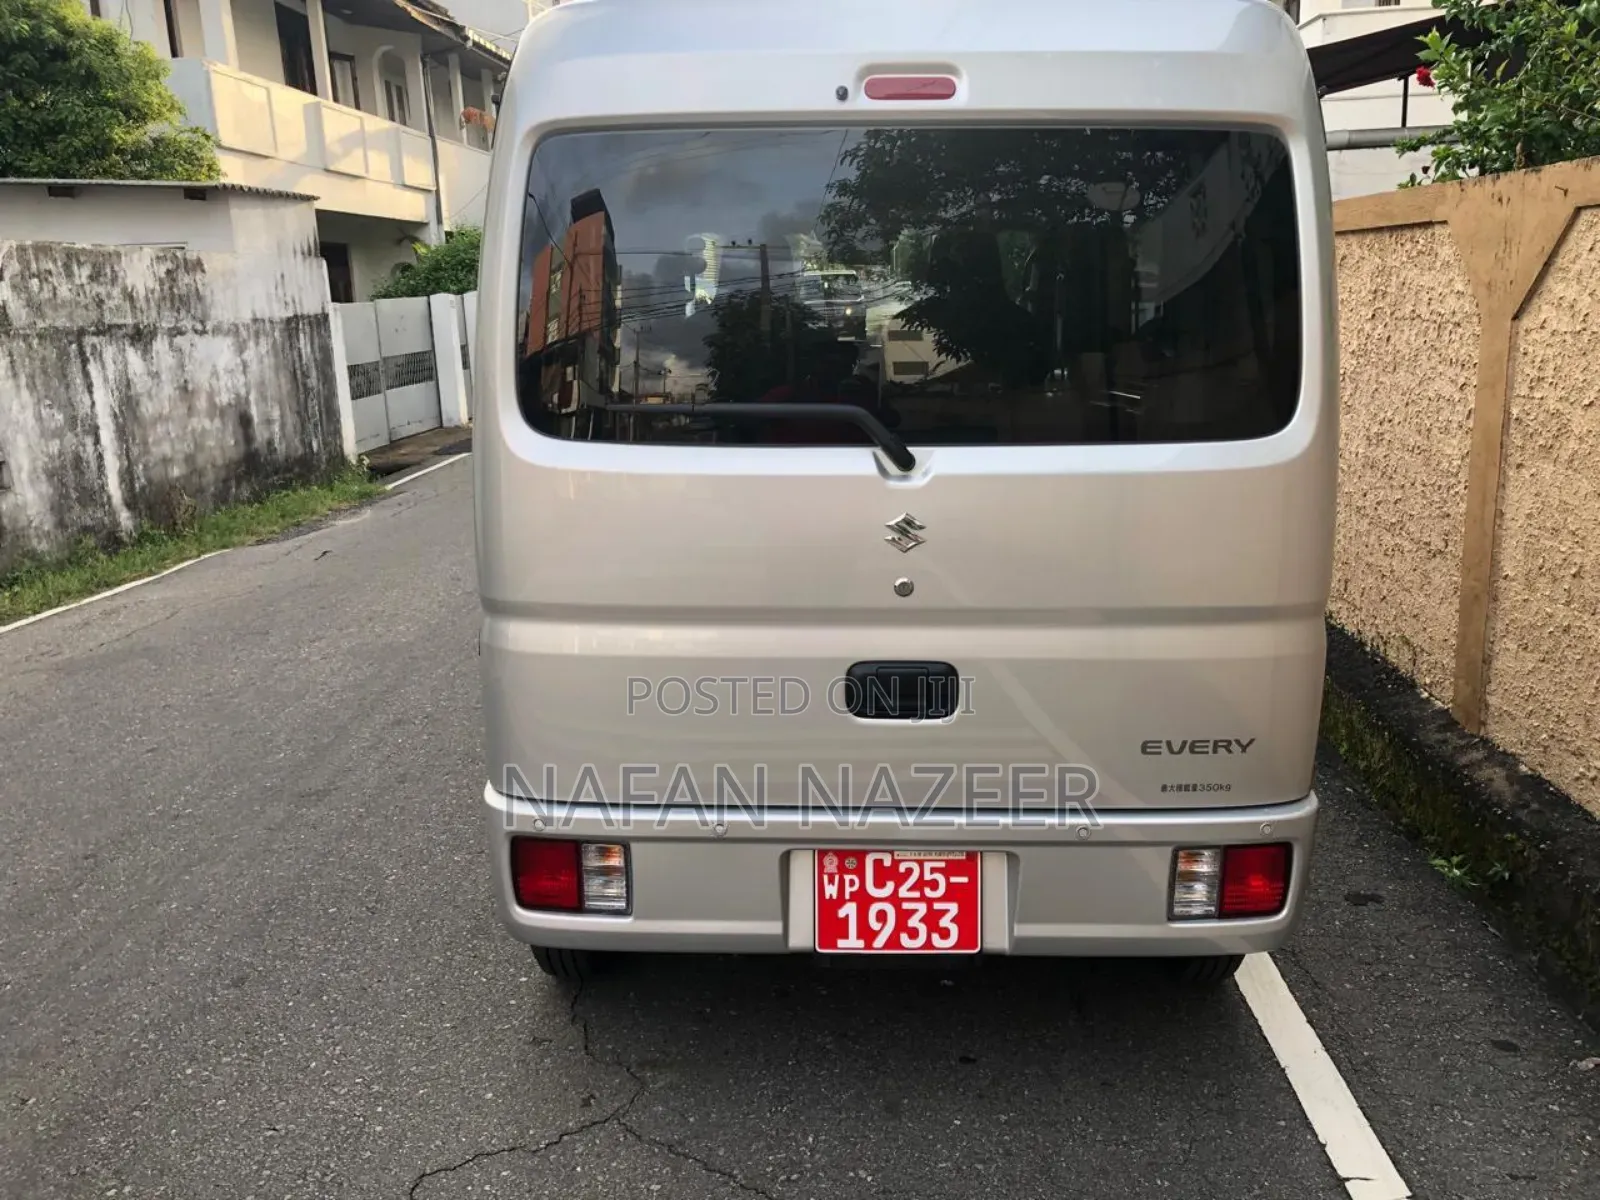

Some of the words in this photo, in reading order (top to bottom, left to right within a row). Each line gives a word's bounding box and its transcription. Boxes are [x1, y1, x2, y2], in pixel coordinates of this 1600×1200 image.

[1140, 738, 1256, 755] EVERY
[823, 874, 860, 900] WP
[836, 902, 959, 949] 1933
